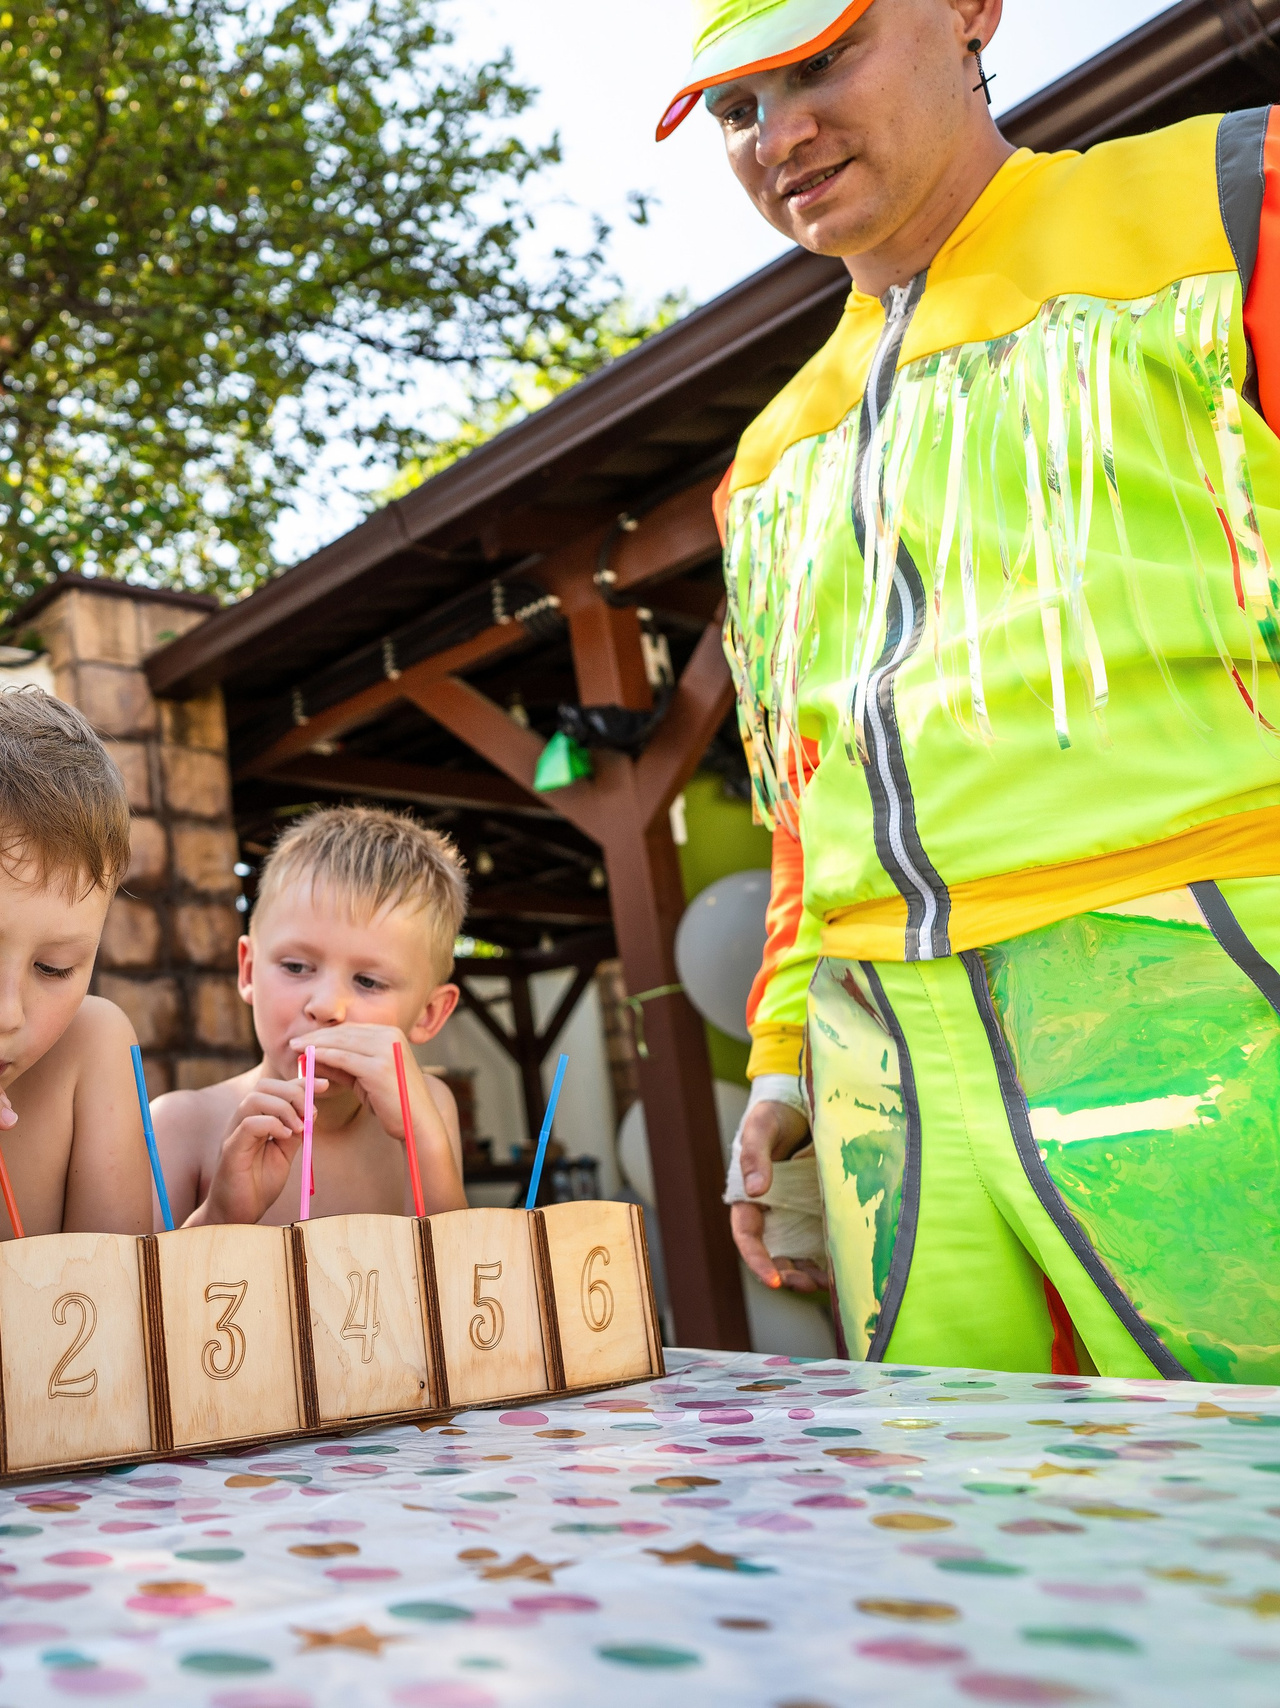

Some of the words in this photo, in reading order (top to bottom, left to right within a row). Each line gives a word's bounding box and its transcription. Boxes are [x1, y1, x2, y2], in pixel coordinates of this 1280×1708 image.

[200, 1279, 249, 1381] 3
[340, 1269, 381, 1364] 4
[469, 1260, 505, 1351] 5
[580, 1245, 615, 1332] 6
[47, 1292, 98, 1399] 2
